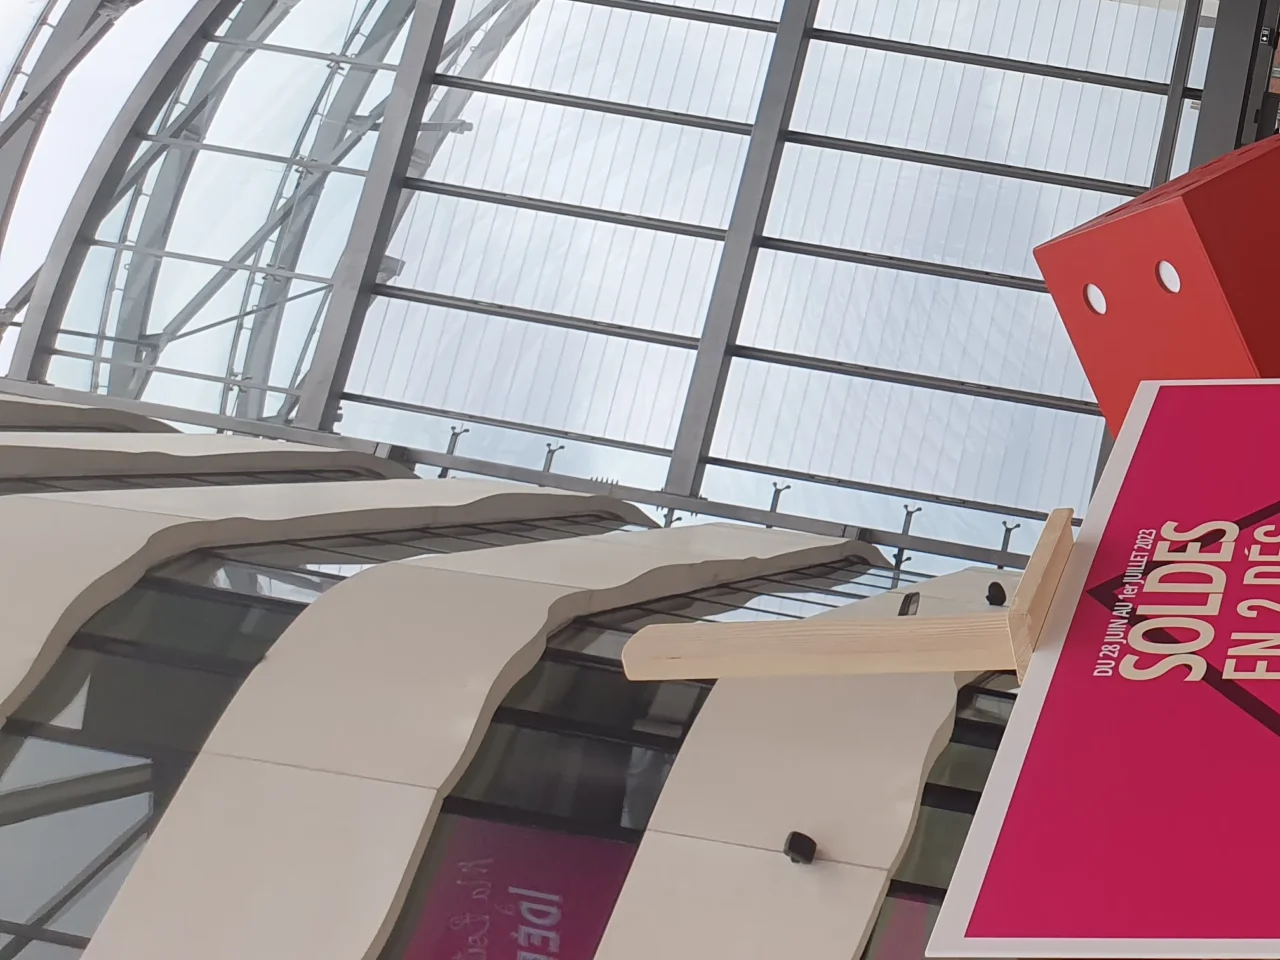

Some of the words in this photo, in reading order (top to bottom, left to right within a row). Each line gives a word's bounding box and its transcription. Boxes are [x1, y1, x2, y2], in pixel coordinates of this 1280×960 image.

[1134, 529, 1156, 550] 2023
[1123, 550, 1149, 584] JUILLET
[1118, 584, 1138, 600] 1er
[1118, 520, 1240, 682] SOLDES
[1112, 602, 1132, 618] AU
[1104, 619, 1128, 644] JUIN
[1100, 644, 1120, 658] 28
[1093, 660, 1115, 677] DU
